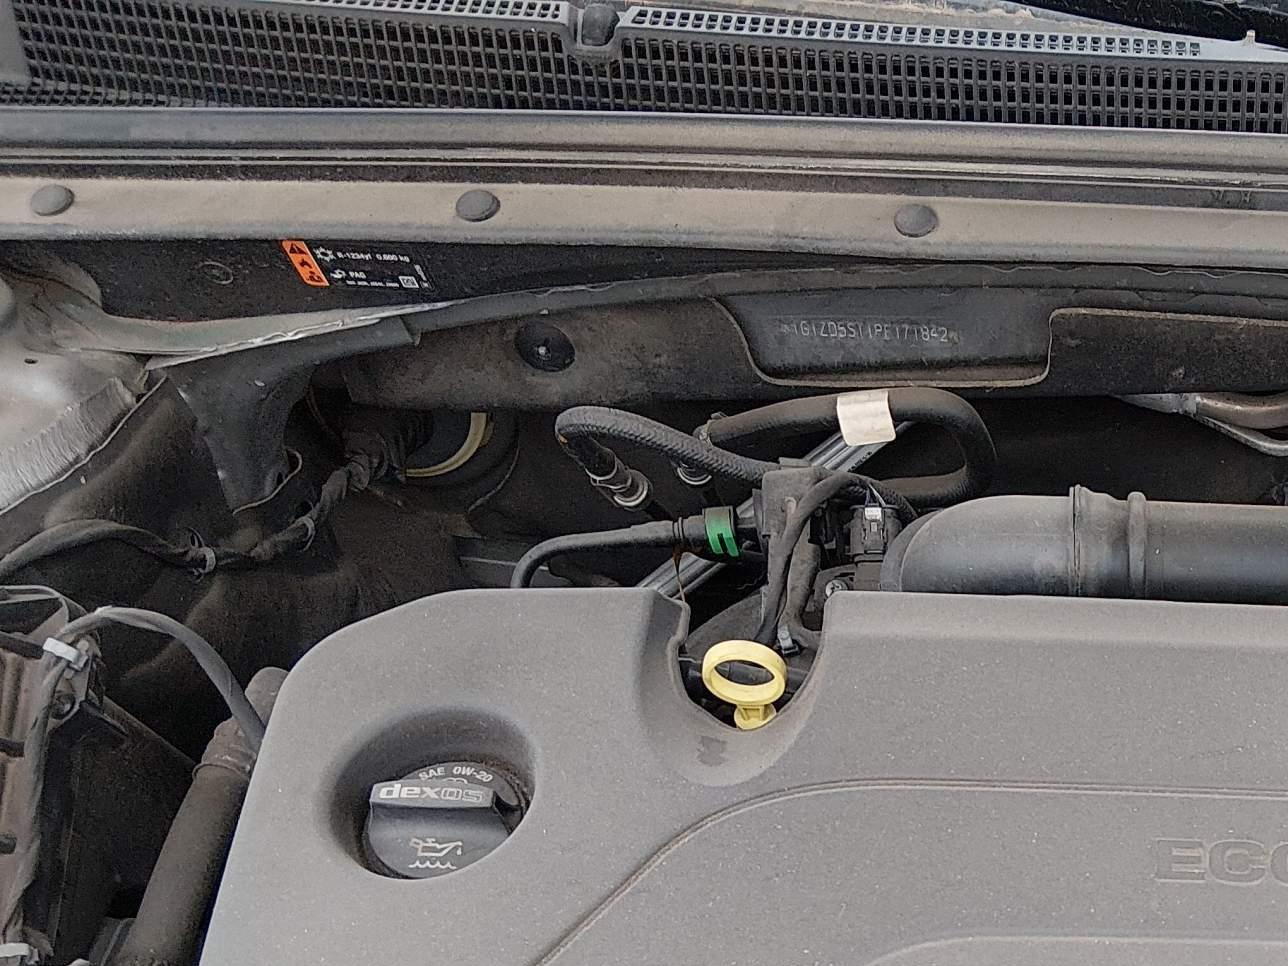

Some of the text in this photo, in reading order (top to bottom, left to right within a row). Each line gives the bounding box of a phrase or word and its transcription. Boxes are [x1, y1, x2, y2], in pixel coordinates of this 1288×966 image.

[418, 766, 494, 783] SAE 0W-20
[379, 783, 484, 803] dexos
